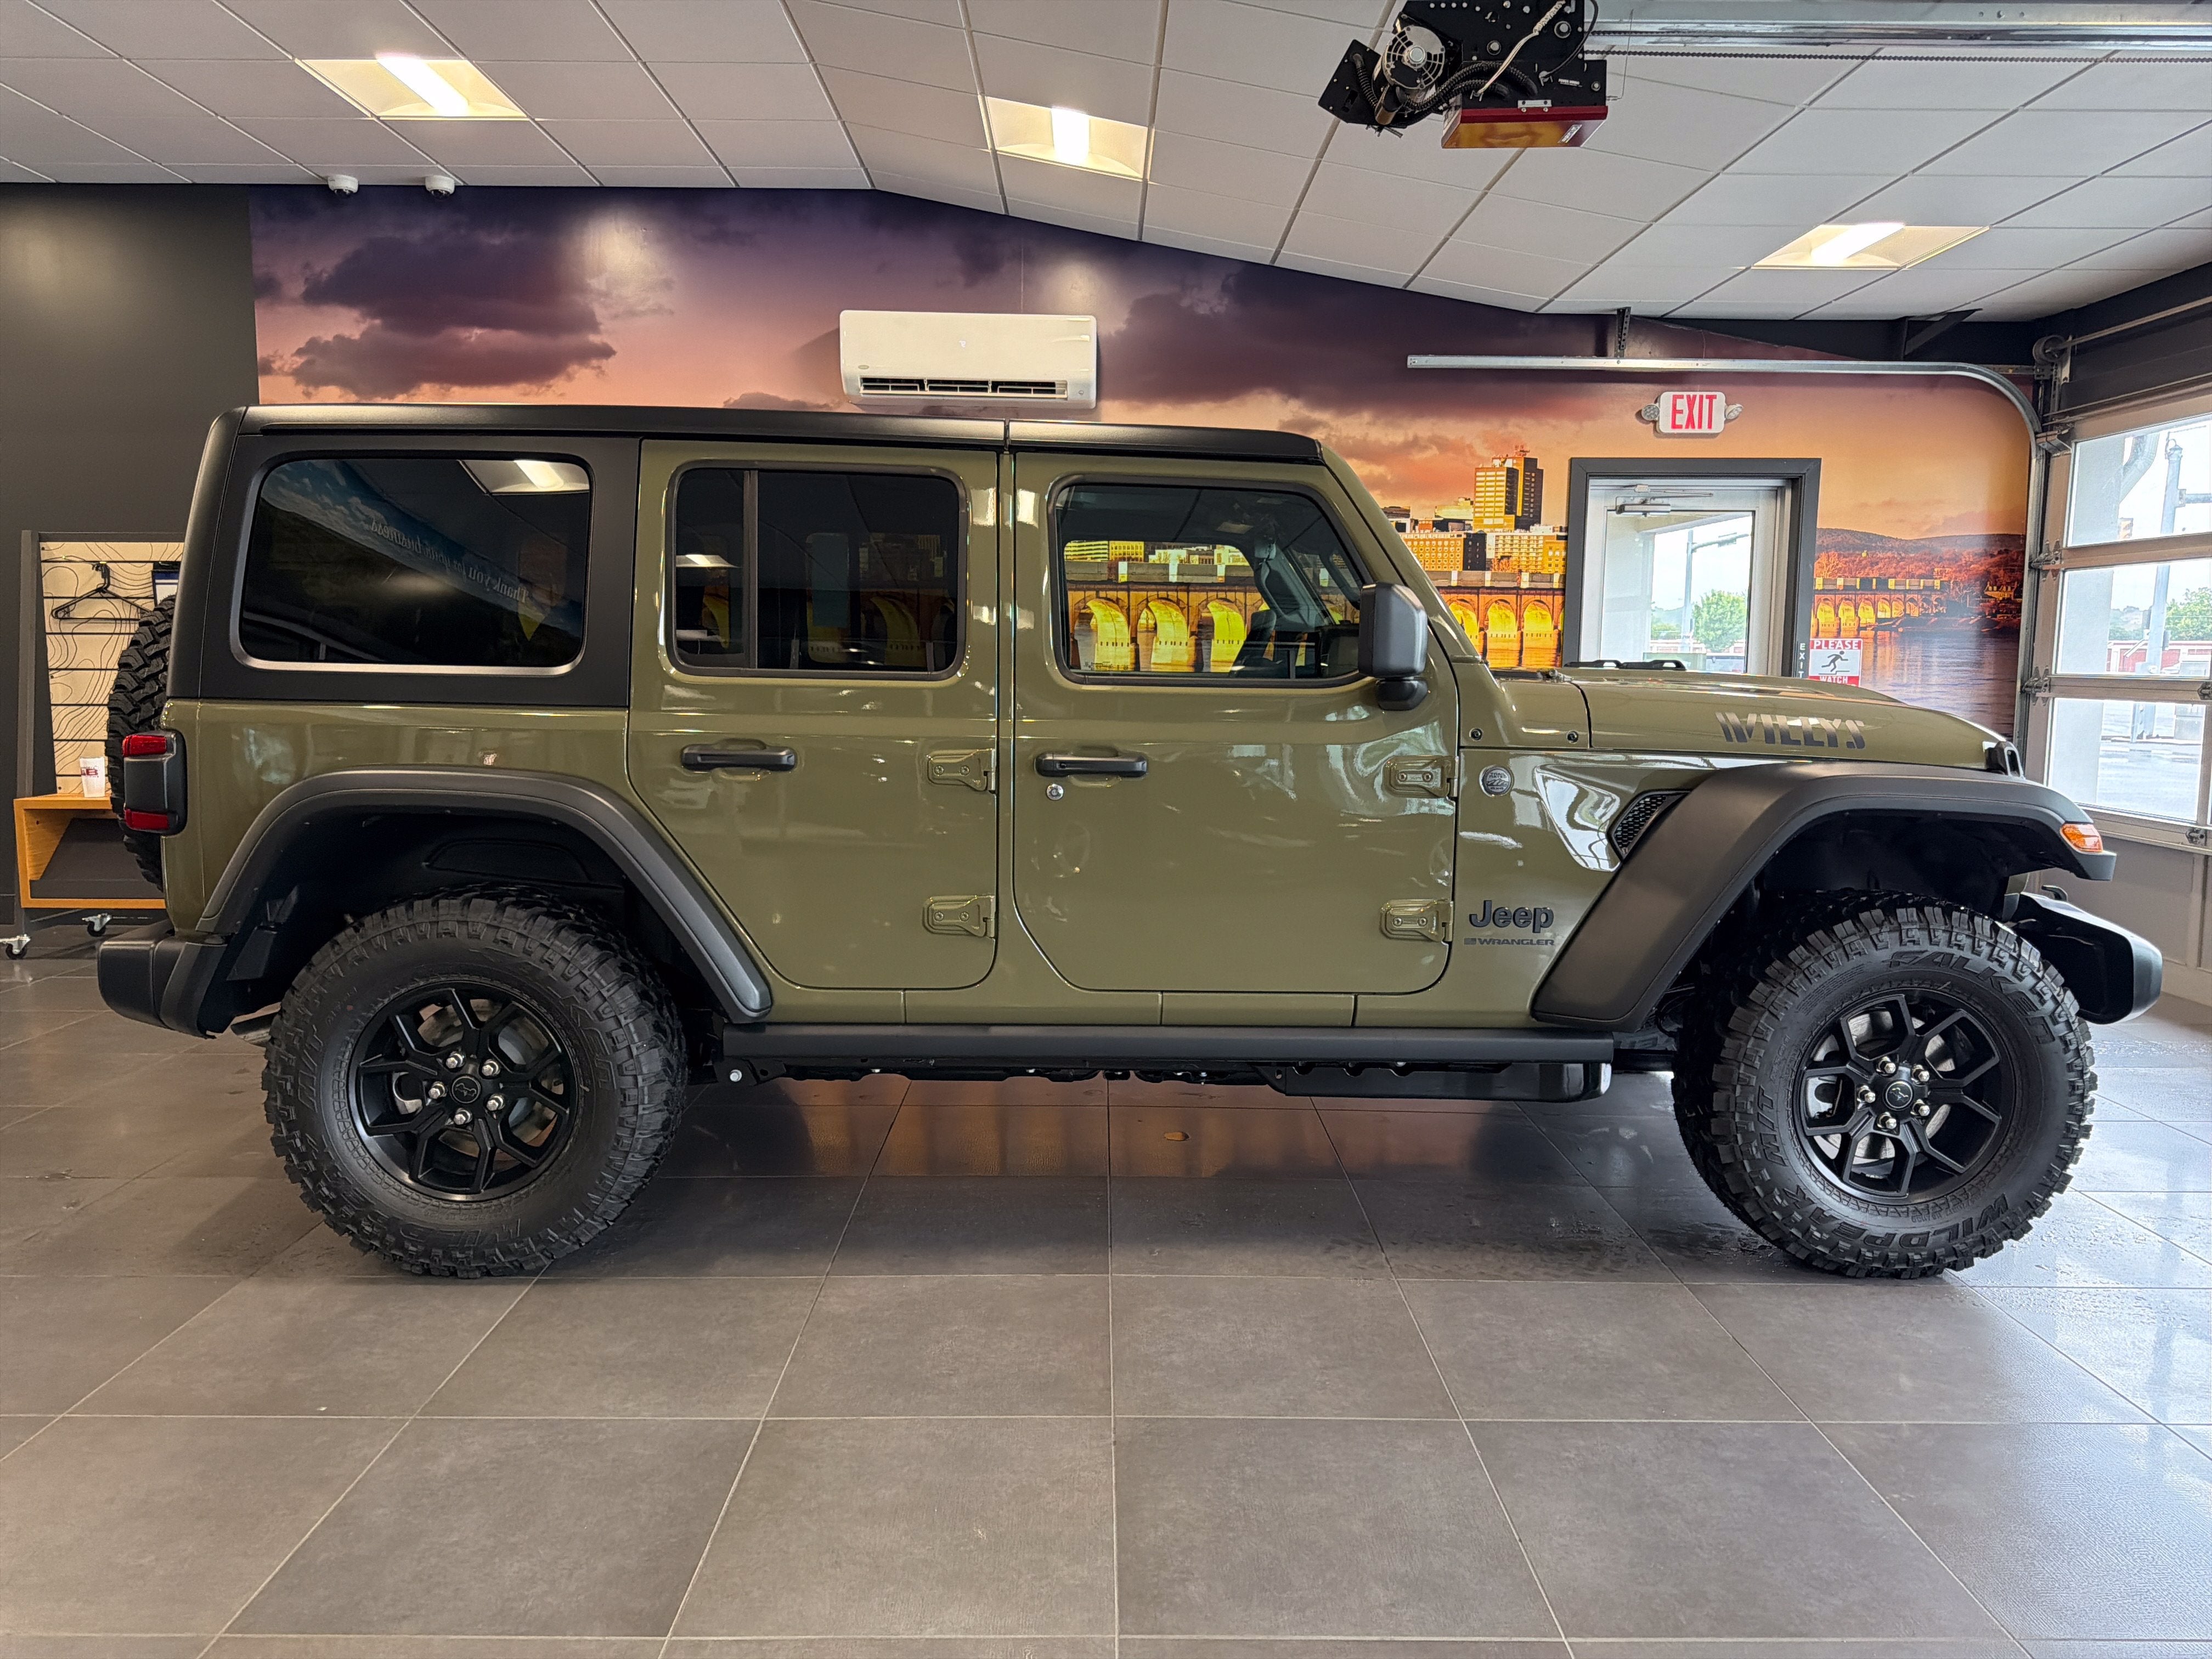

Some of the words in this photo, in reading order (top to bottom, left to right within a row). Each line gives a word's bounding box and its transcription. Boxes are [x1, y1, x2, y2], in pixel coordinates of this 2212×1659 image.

[1671, 394, 1717, 430] EXIT
[1798, 642, 1806, 679] EXIT
[1813, 640, 1859, 650] PLEASE
[1819, 675, 1848, 684] WATCH
[1715, 711, 1866, 749] WILLYS
[1469, 900, 1554, 934] Jeep
[1477, 938, 1555, 946] WRANGLER
[1783, 1184, 2009, 1249] WILDPEAK
